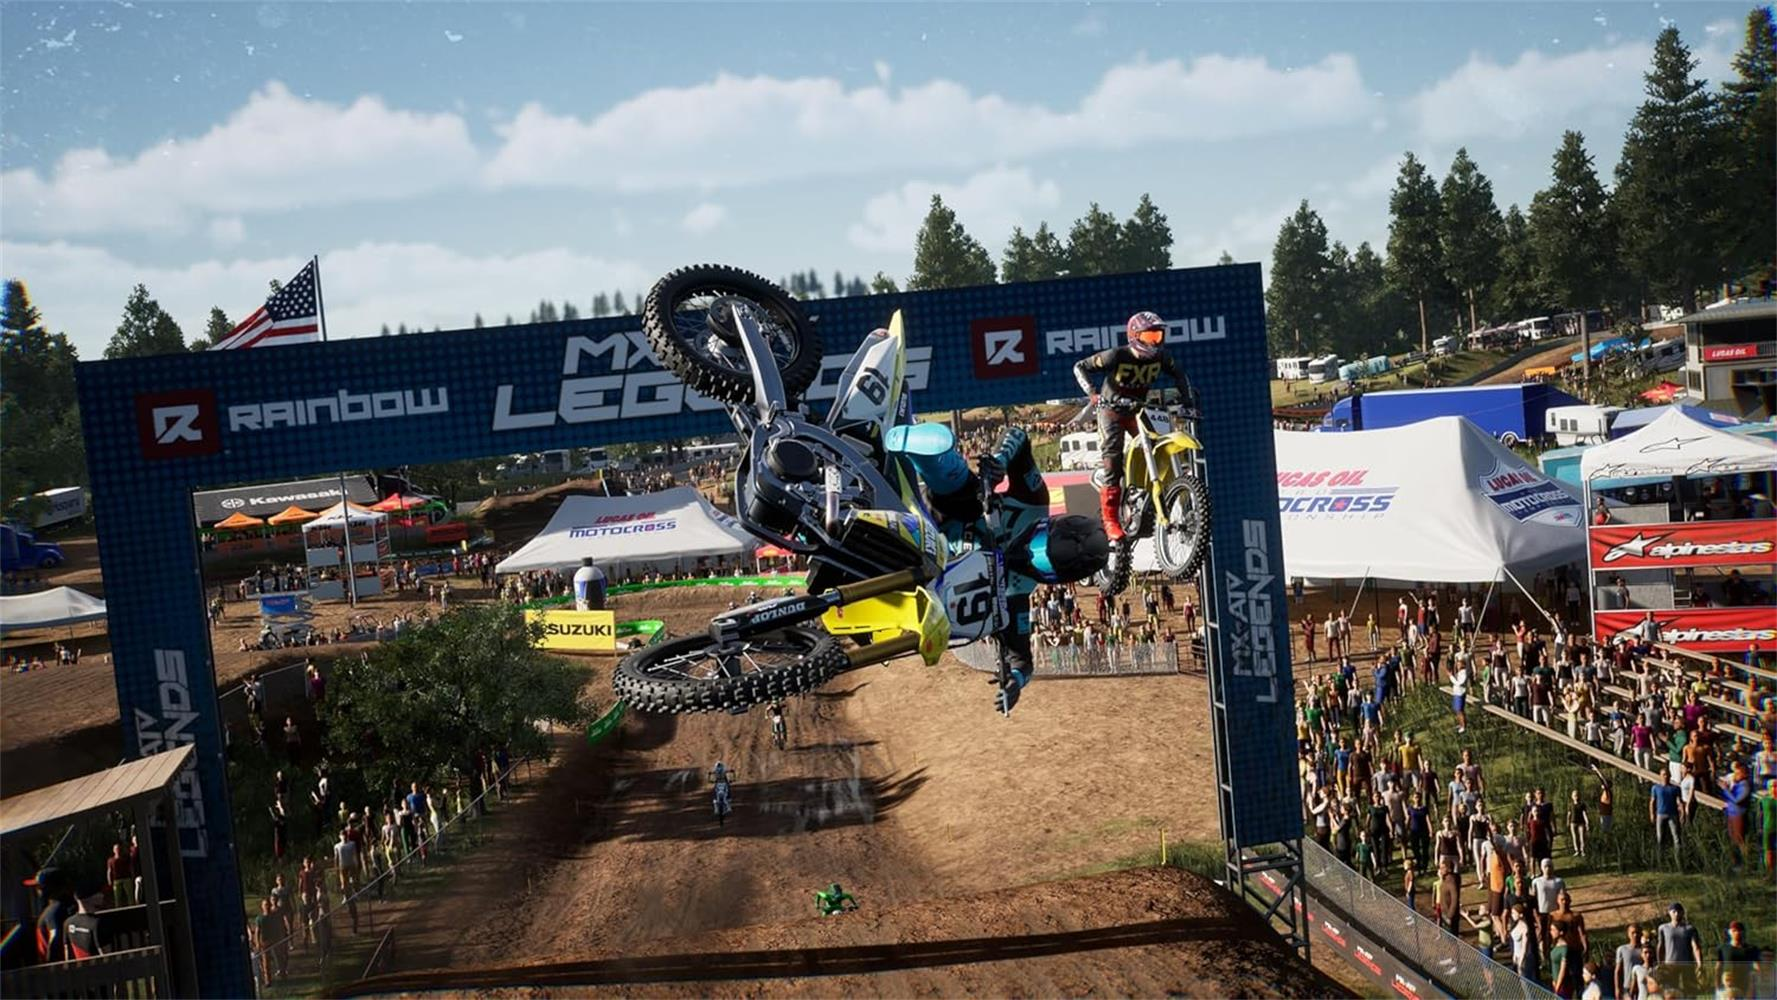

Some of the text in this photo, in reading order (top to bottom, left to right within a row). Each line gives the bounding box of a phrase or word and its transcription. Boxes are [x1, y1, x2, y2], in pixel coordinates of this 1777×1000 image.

[1277, 469, 1369, 488] UCAS OIL
[569, 521, 677, 539] MOTOCROSS
[1649, 540, 1775, 559] alpinestars
[953, 572, 991, 626] 19
[751, 602, 806, 625] DUNLOP
[1242, 519, 1279, 703] LEGENDS
[547, 623, 612, 637] SUZUKI
